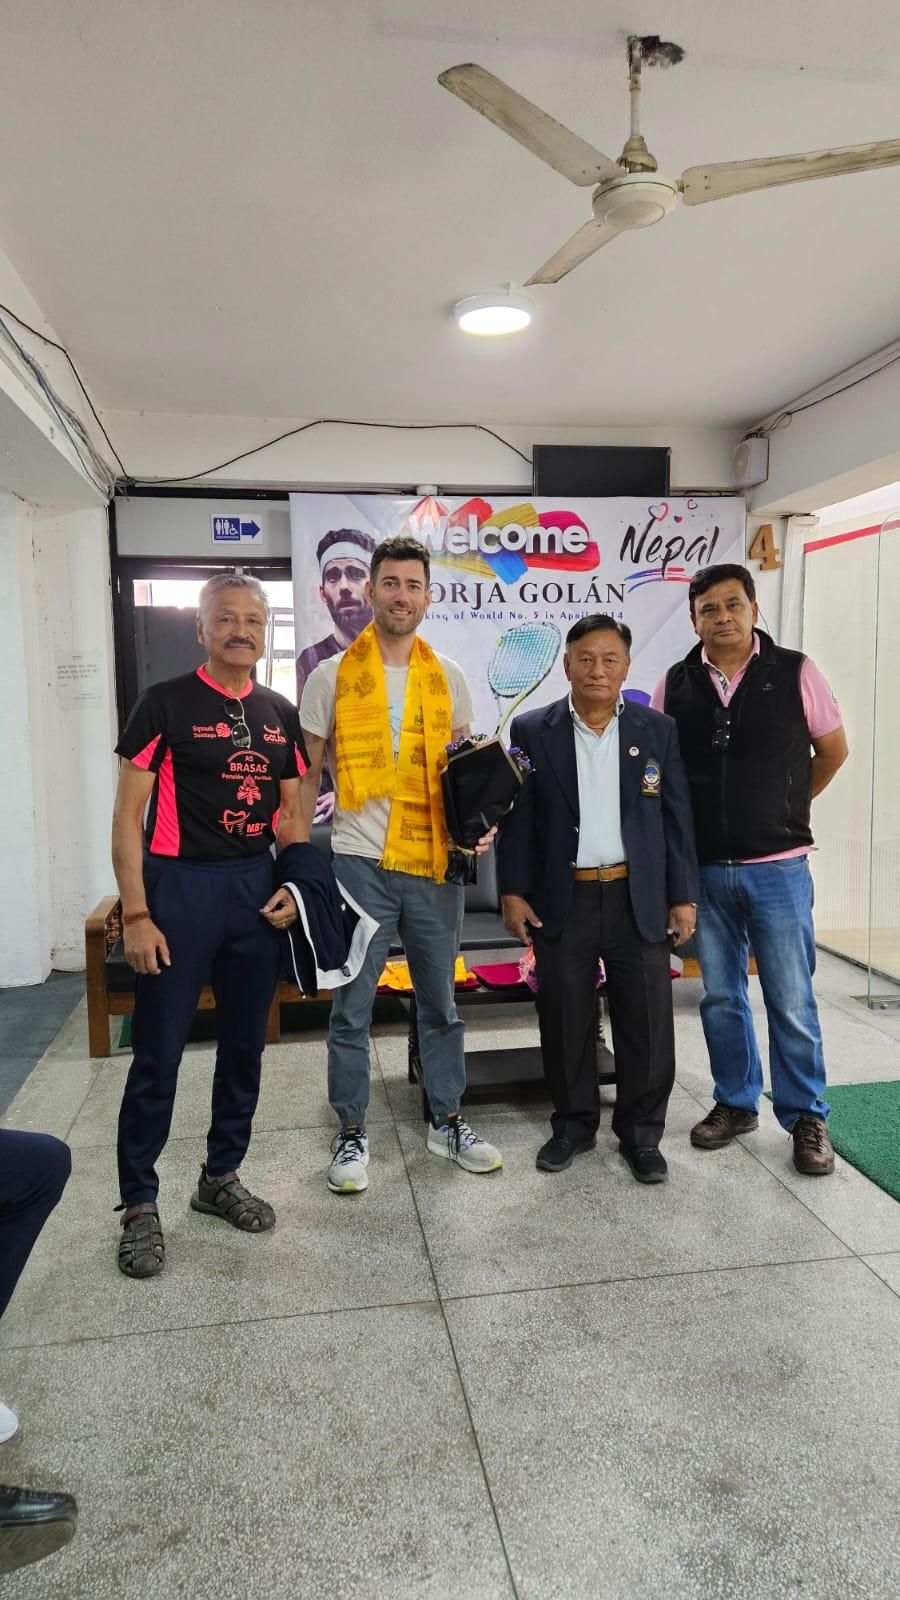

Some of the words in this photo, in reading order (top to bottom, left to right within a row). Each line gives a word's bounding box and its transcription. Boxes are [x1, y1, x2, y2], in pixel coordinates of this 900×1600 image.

[408, 514, 589, 554] Welcome
[619, 515, 720, 578] Nepal
[749, 524, 784, 571] 4
[430, 583, 507, 610] ORJA
[519, 576, 626, 604] GOLÁN
[425, 610, 448, 621] king
[454, 611, 464, 620] of
[470, 611, 503, 620] World
[509, 611, 527, 620] No.
[595, 611, 623, 619] 014
[230, 762, 268, 773] BRASAS
